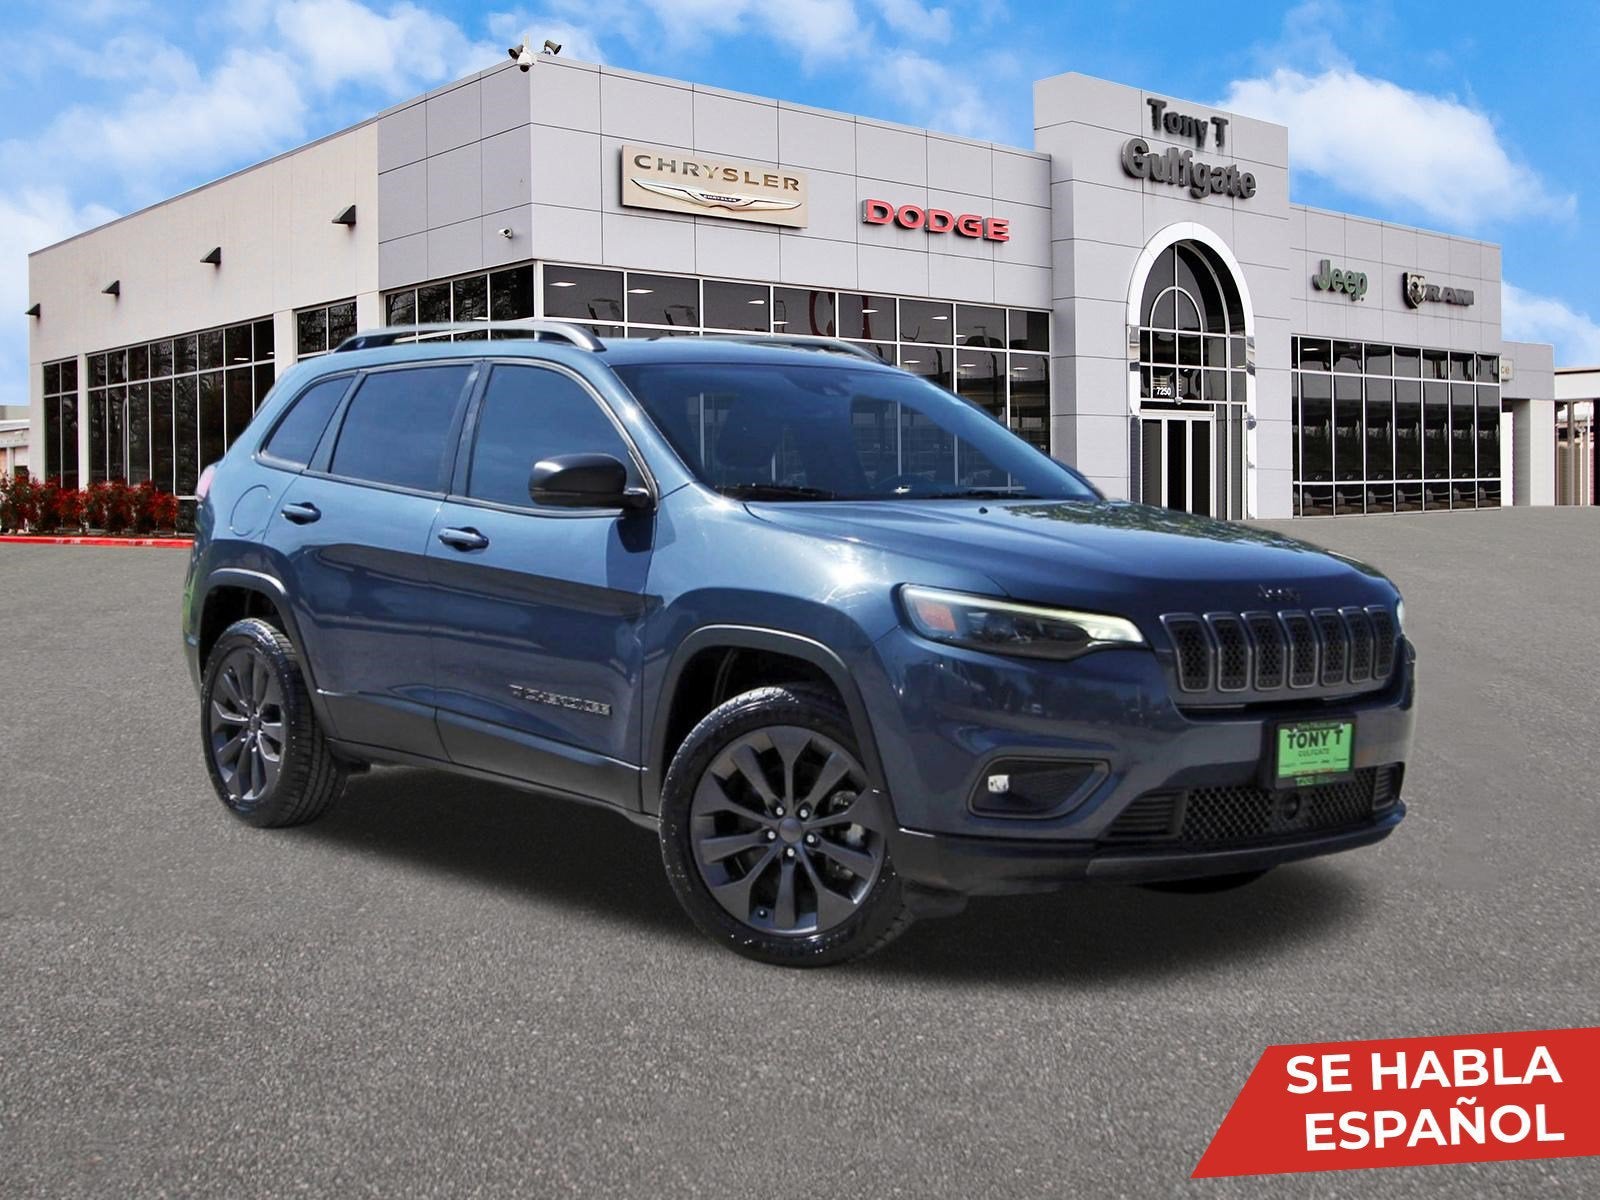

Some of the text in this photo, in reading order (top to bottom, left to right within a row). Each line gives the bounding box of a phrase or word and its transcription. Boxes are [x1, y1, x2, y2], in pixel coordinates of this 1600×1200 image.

[1146, 97, 1229, 148] Tony T
[633, 154, 801, 192] CHRYSLER
[1120, 137, 1257, 199] Gulfgate
[862, 198, 1010, 243] DODGE
[1312, 258, 1368, 302] Jeep
[1424, 284, 1475, 306] RAM
[1156, 386, 1172, 396] 7250
[1287, 728, 1344, 750] TONY T
